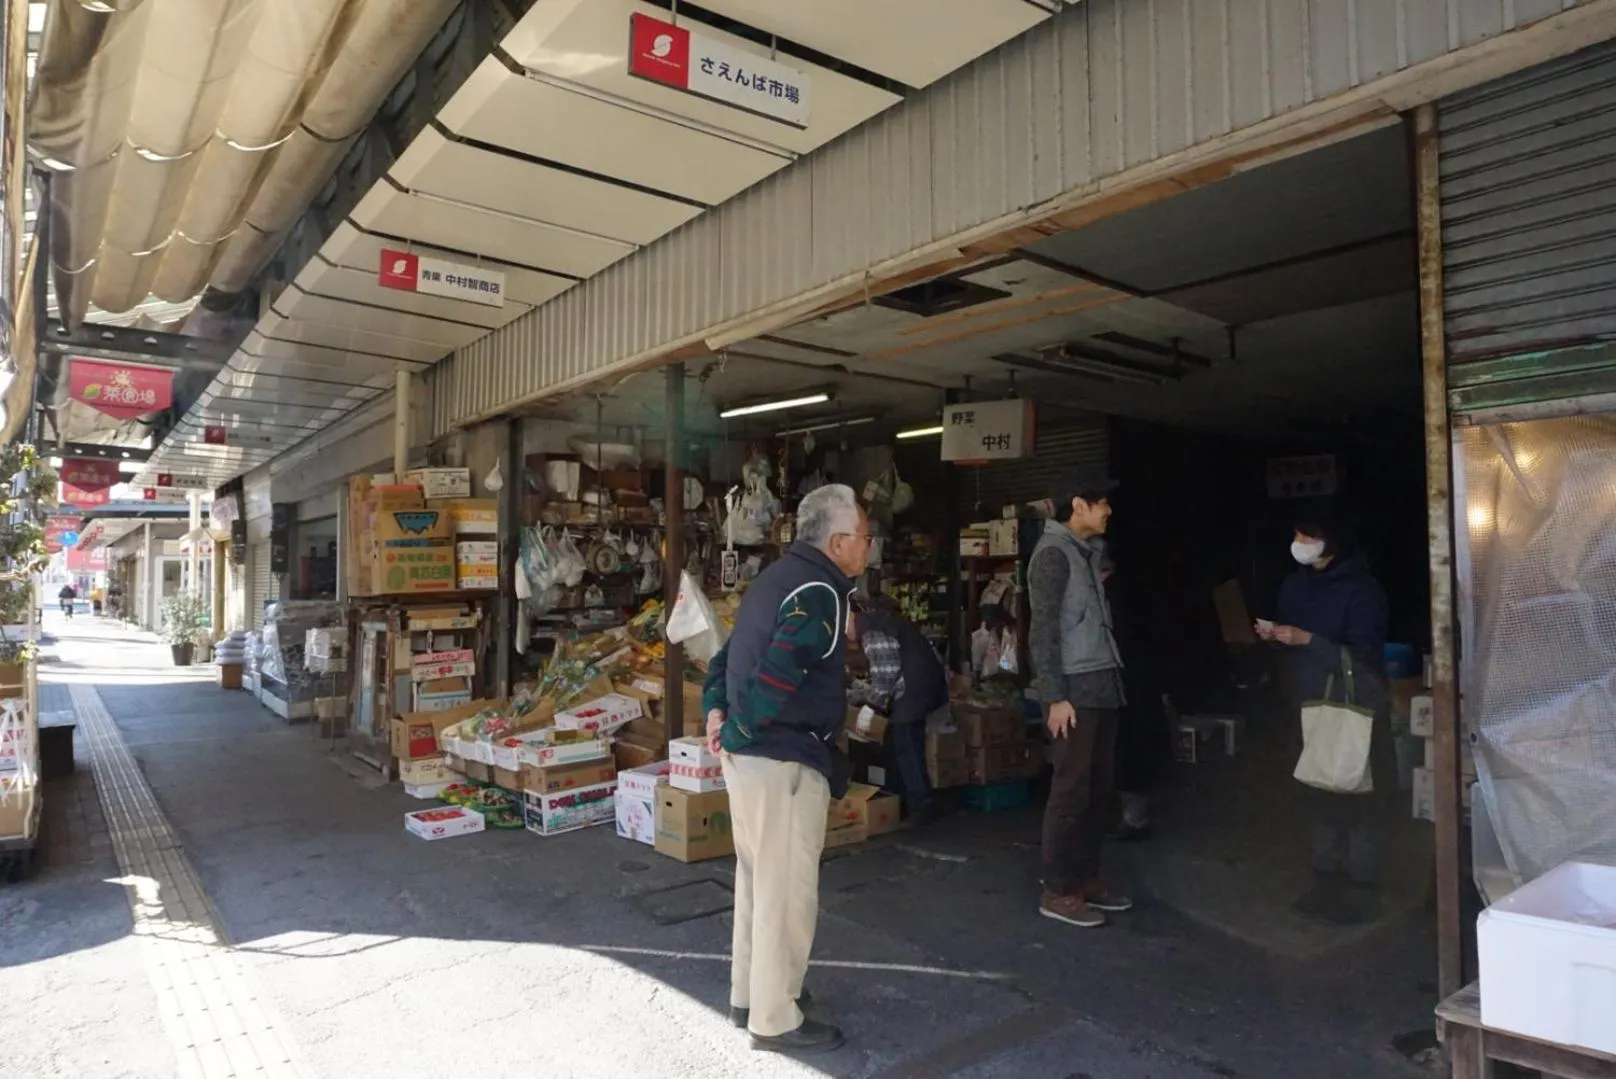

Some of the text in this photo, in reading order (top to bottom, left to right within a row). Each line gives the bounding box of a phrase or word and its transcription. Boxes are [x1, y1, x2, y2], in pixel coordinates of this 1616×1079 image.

[700, 56, 800, 104] さえんば市場
[422, 269, 441, 282] 青果
[445, 274, 500, 294] 中村智商店
[103, 385, 156, 405] 菜園場
[951, 410, 976, 425] 野菜
[982, 432, 1011, 451] 中村
